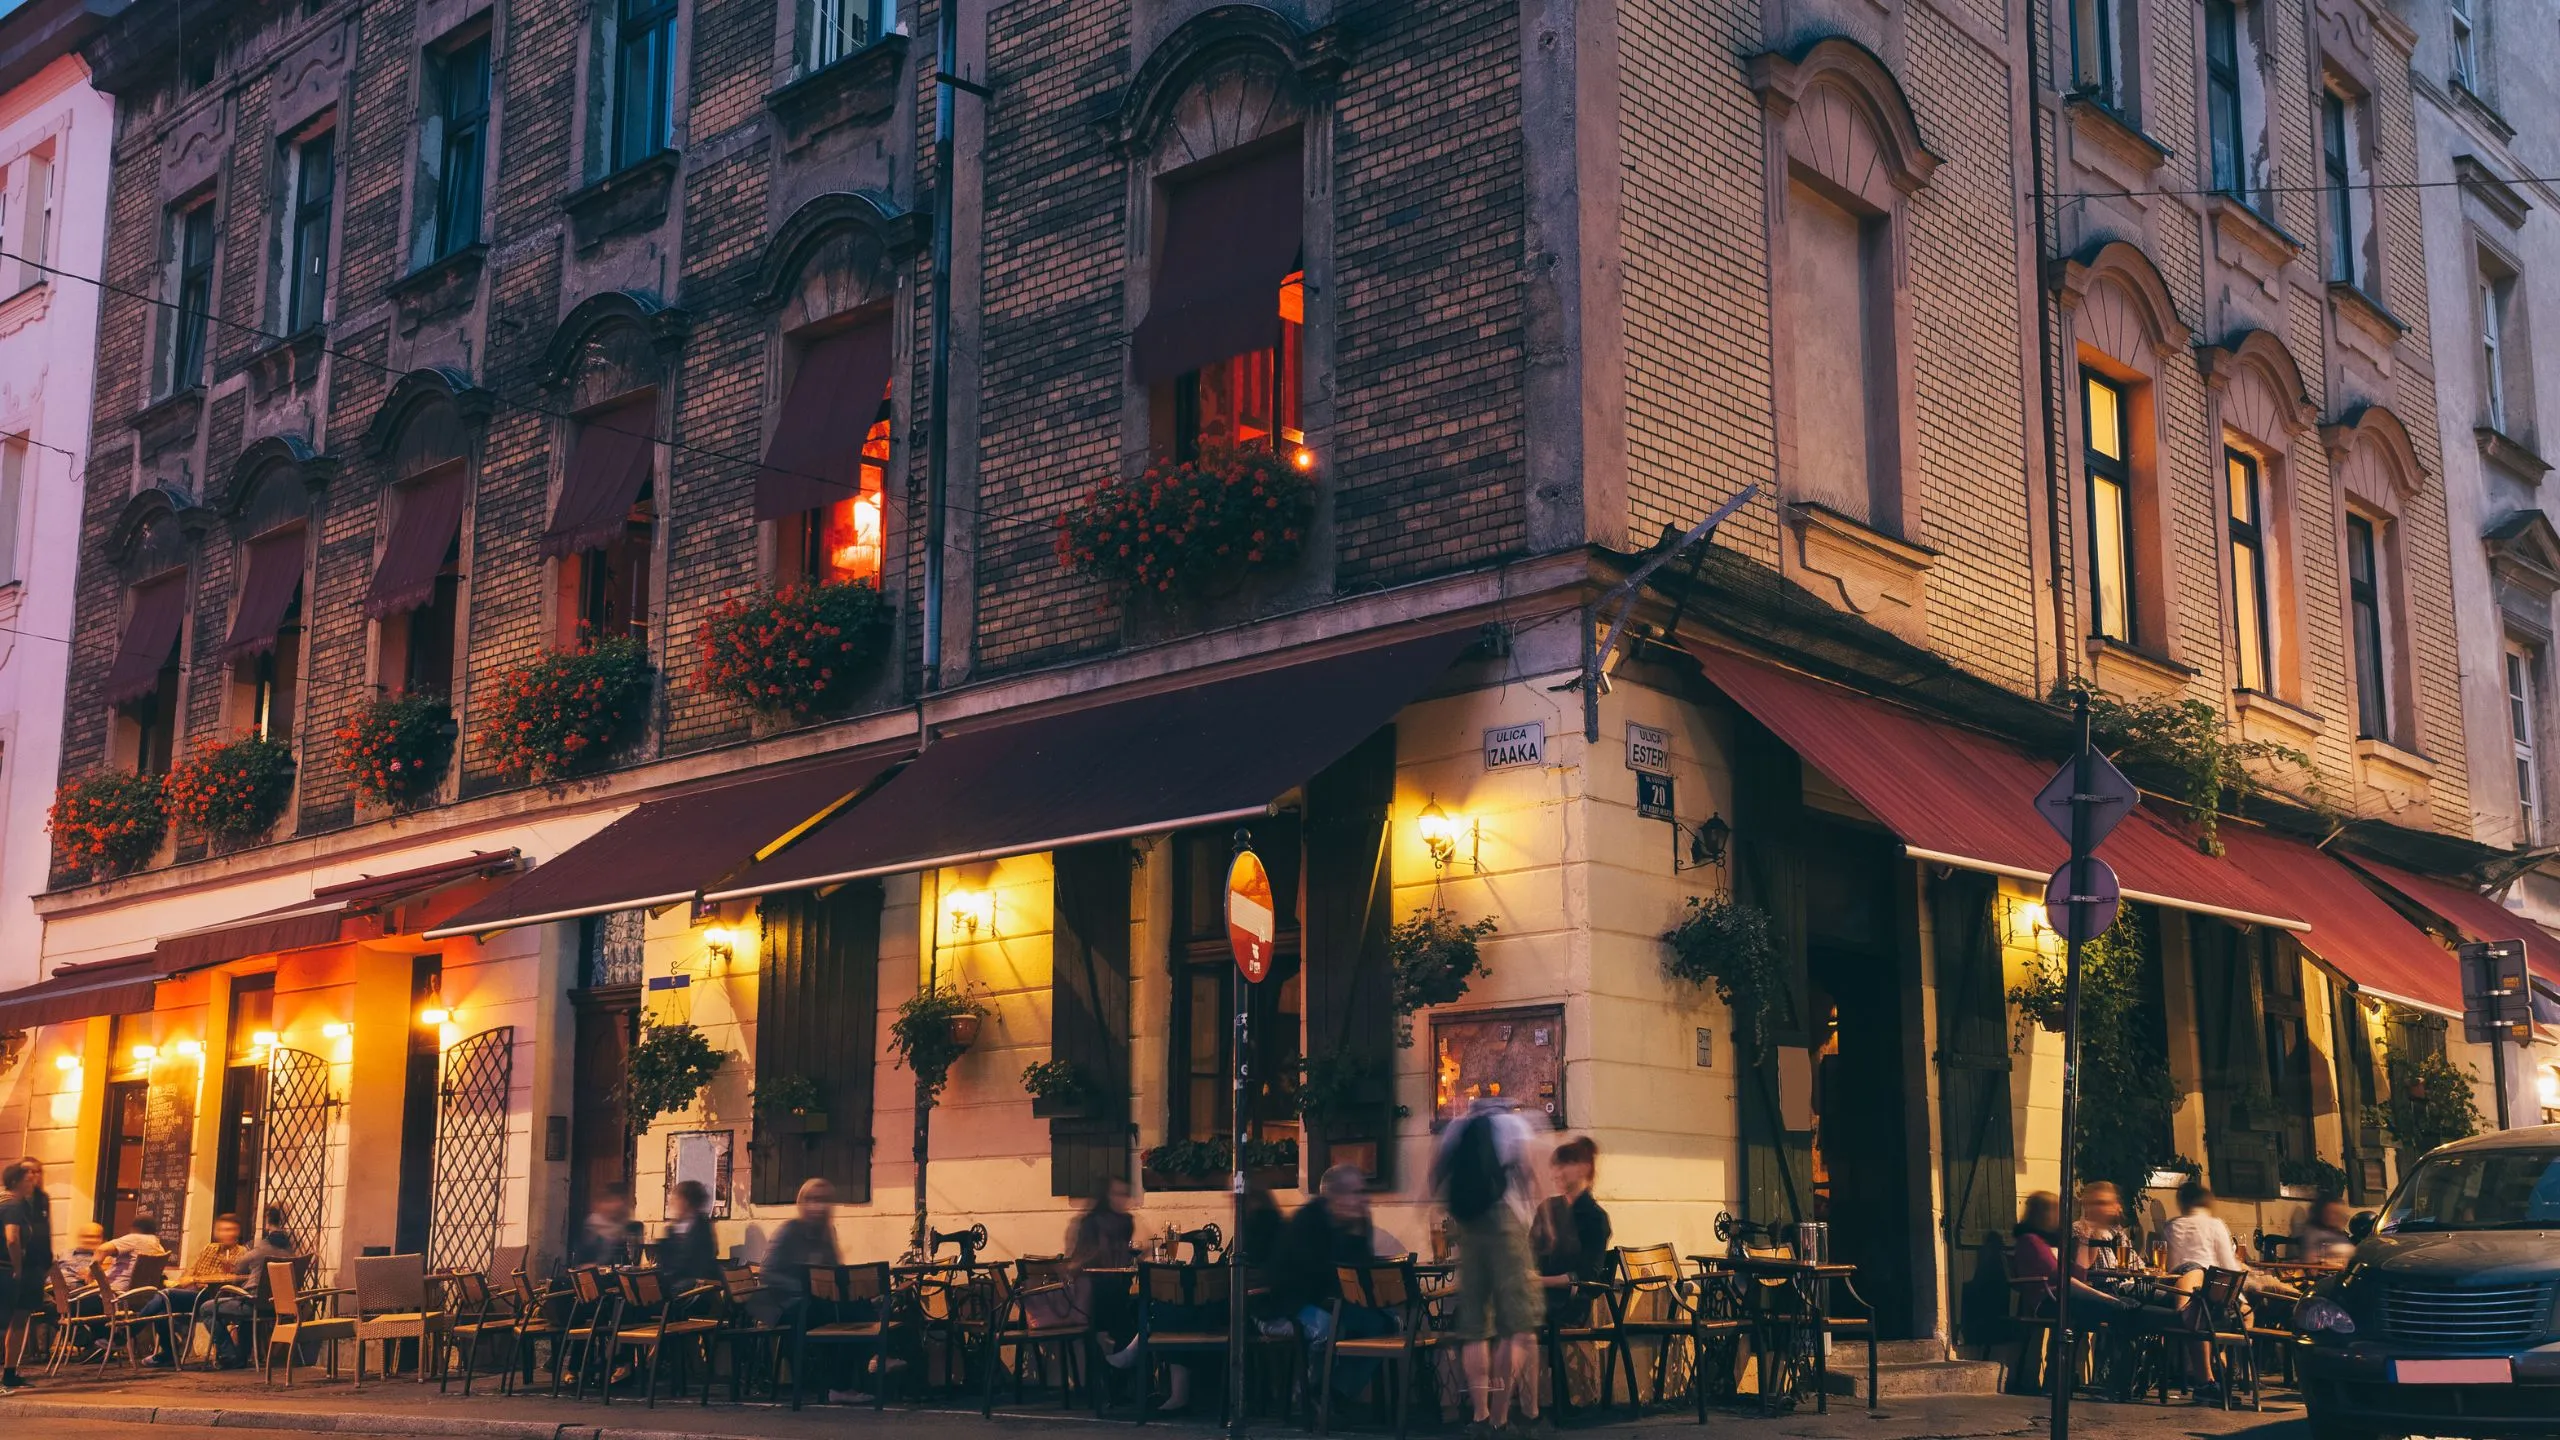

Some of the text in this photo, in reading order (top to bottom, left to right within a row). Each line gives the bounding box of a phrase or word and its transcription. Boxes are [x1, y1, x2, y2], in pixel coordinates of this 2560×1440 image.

[1496, 729, 1526, 742] ULICA
[1639, 729, 1662, 744] ULICA
[1487, 742, 1538, 767] IZAAKA
[1633, 743, 1668, 769] ESTERY
[1652, 784, 1666, 806] 20
